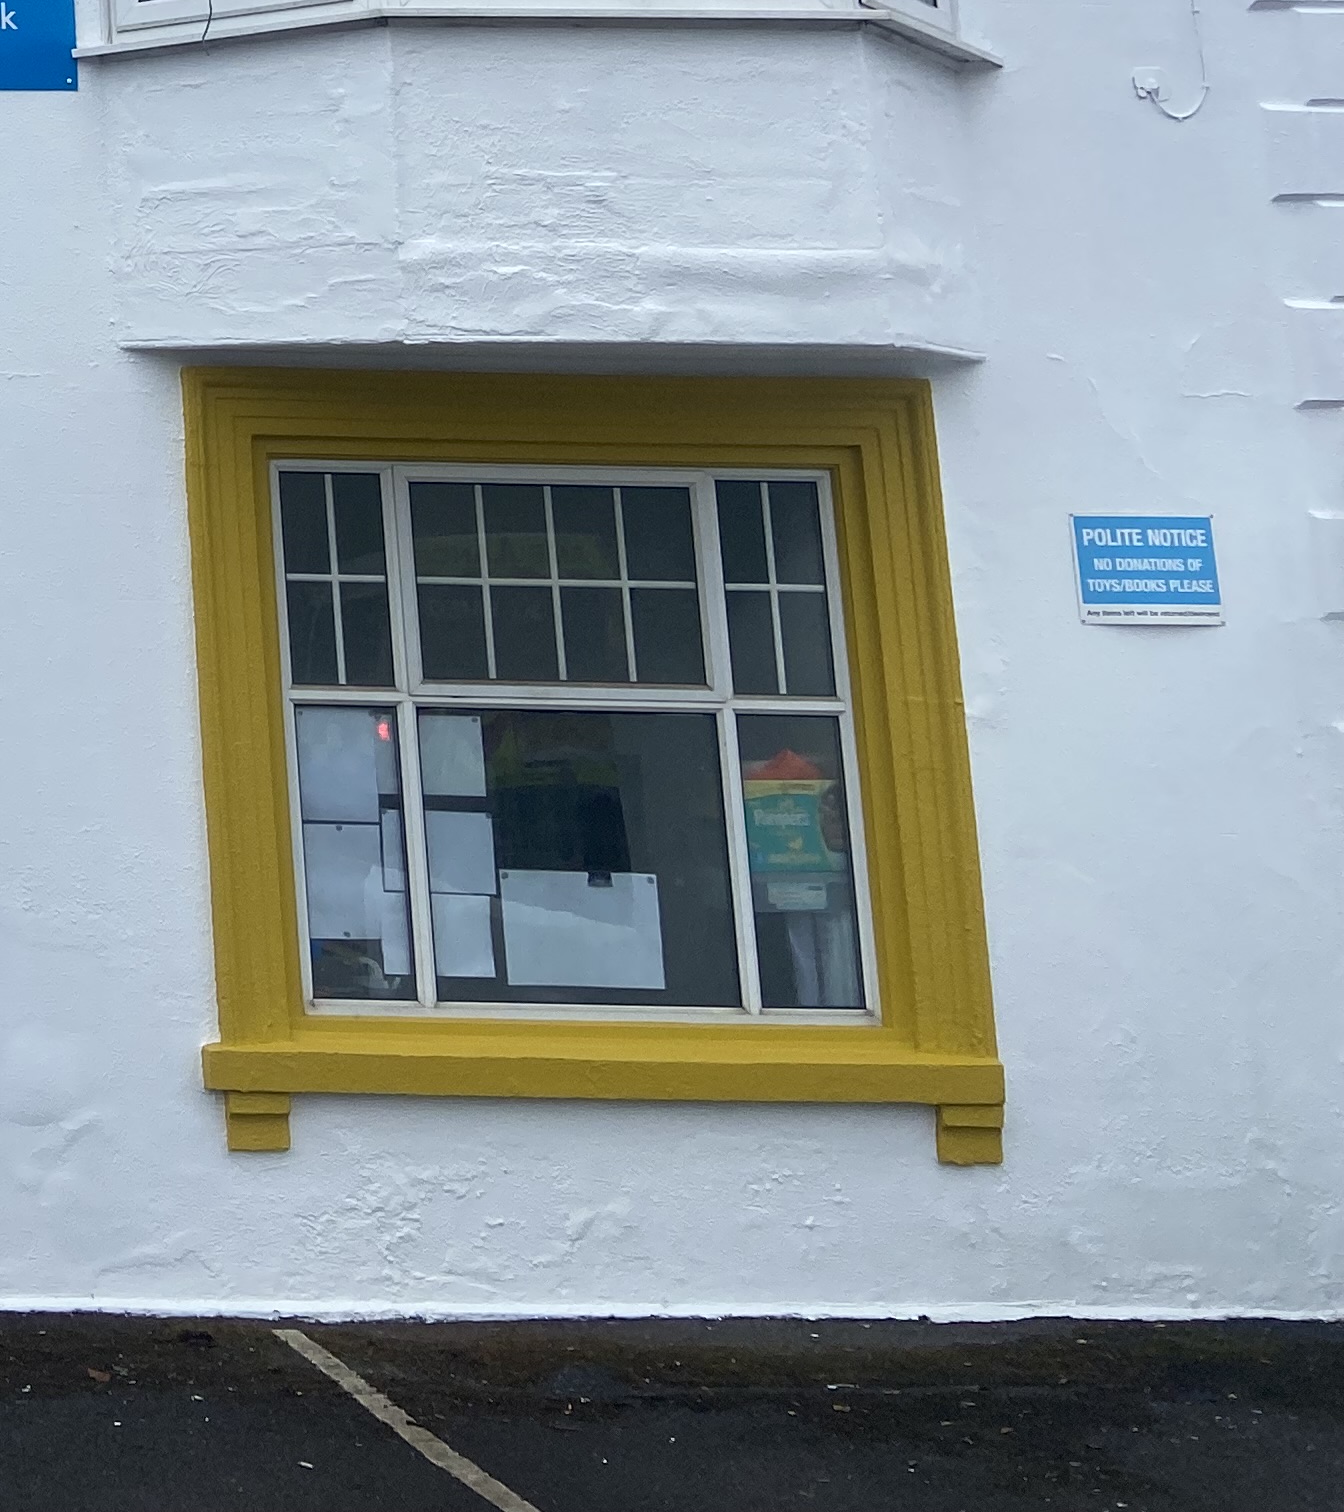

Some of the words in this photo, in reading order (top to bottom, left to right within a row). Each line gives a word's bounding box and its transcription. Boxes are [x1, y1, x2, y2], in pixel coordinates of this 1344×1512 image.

[1082, 528, 1144, 546] POLITE
[1148, 529, 1208, 547] NOTICE
[1094, 558, 1111, 570] NO
[1116, 558, 1184, 571] DONATIONS
[1188, 559, 1203, 571] OF
[1087, 579, 1166, 592] TOYS/BOOKS
[1169, 580, 1214, 593] PLEASE
